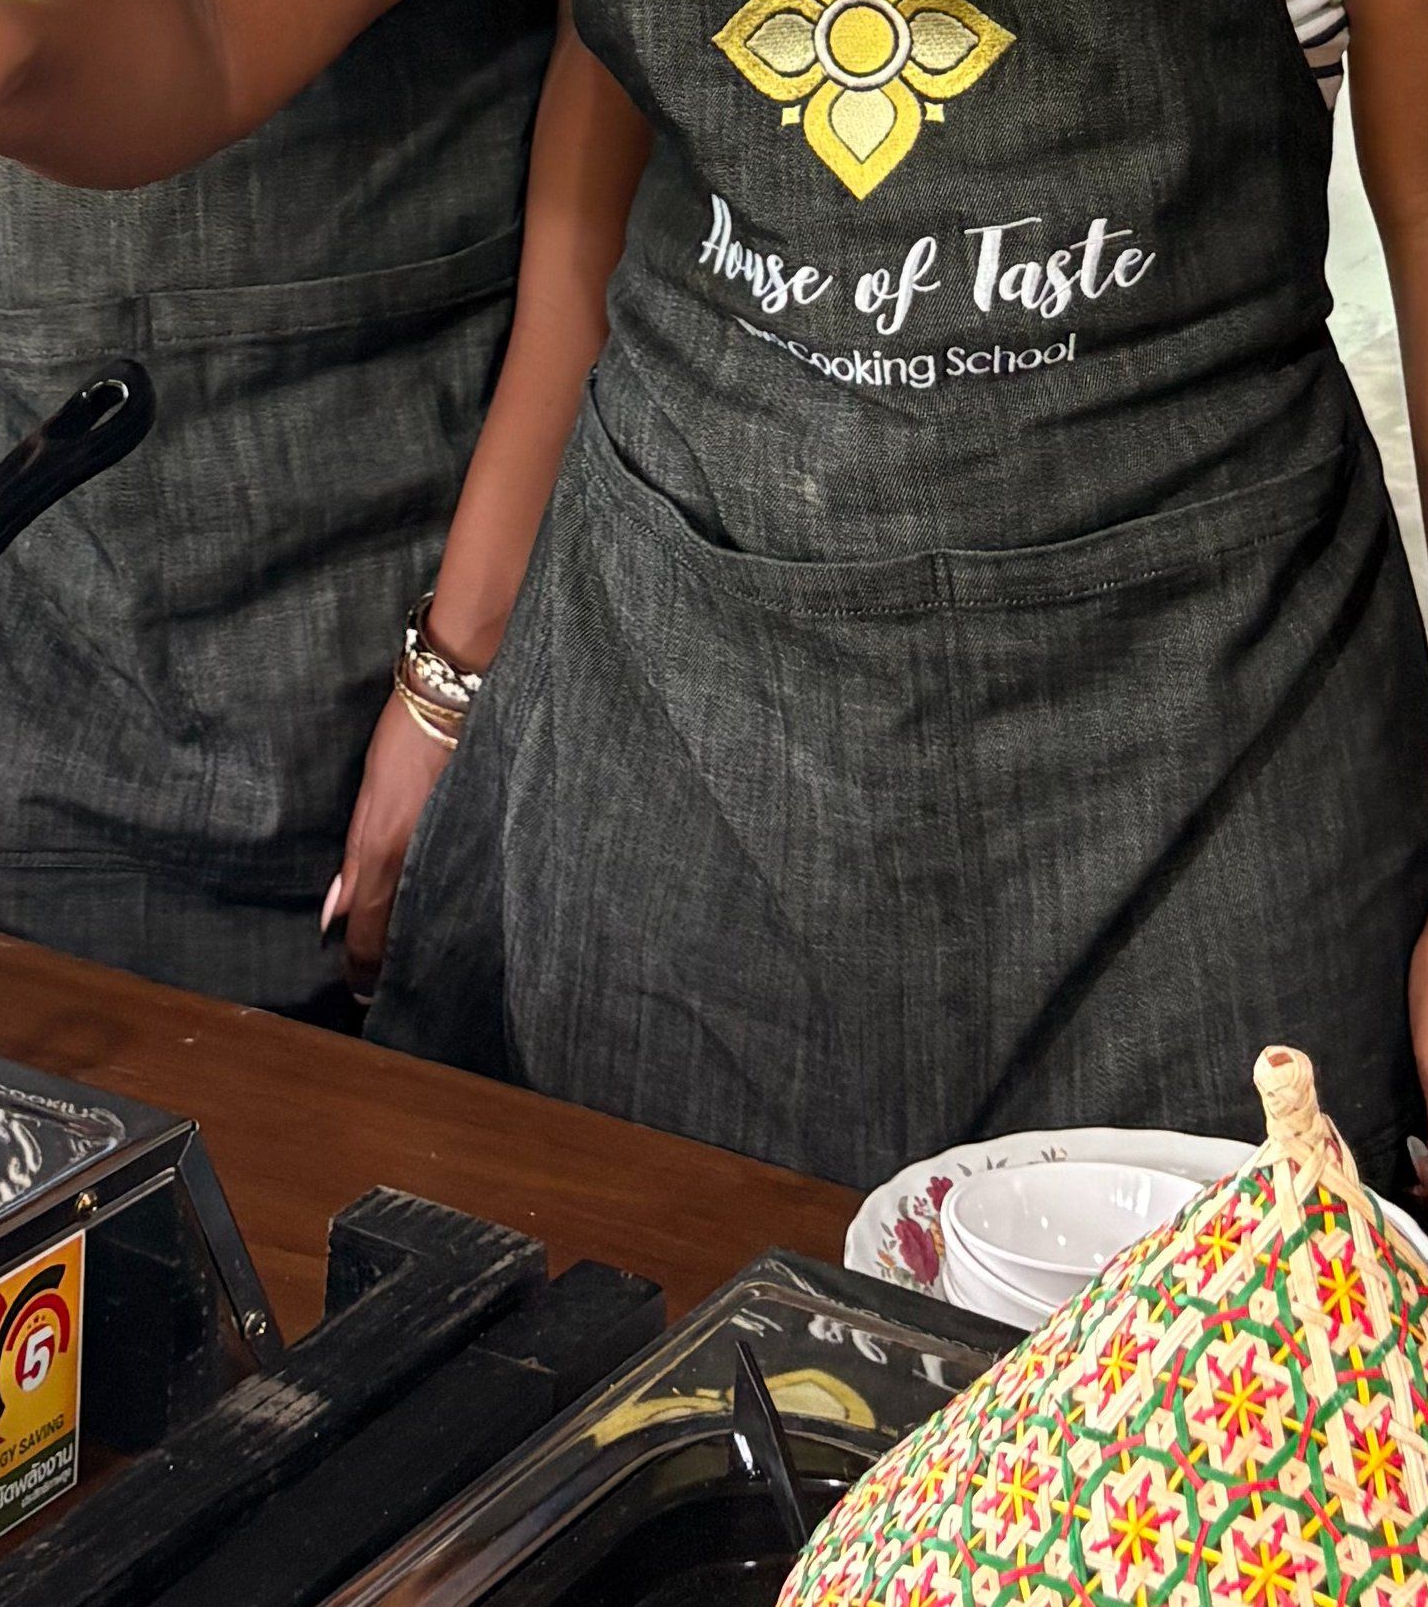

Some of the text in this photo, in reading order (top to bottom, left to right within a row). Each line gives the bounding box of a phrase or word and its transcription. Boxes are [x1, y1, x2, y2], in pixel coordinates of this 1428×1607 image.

[698, 194, 1156, 335] House of Taste
[786, 333, 1077, 389] Cooking School
[21, 1324, 55, 1392] 5
[18, 1413, 65, 1456] SAVING
